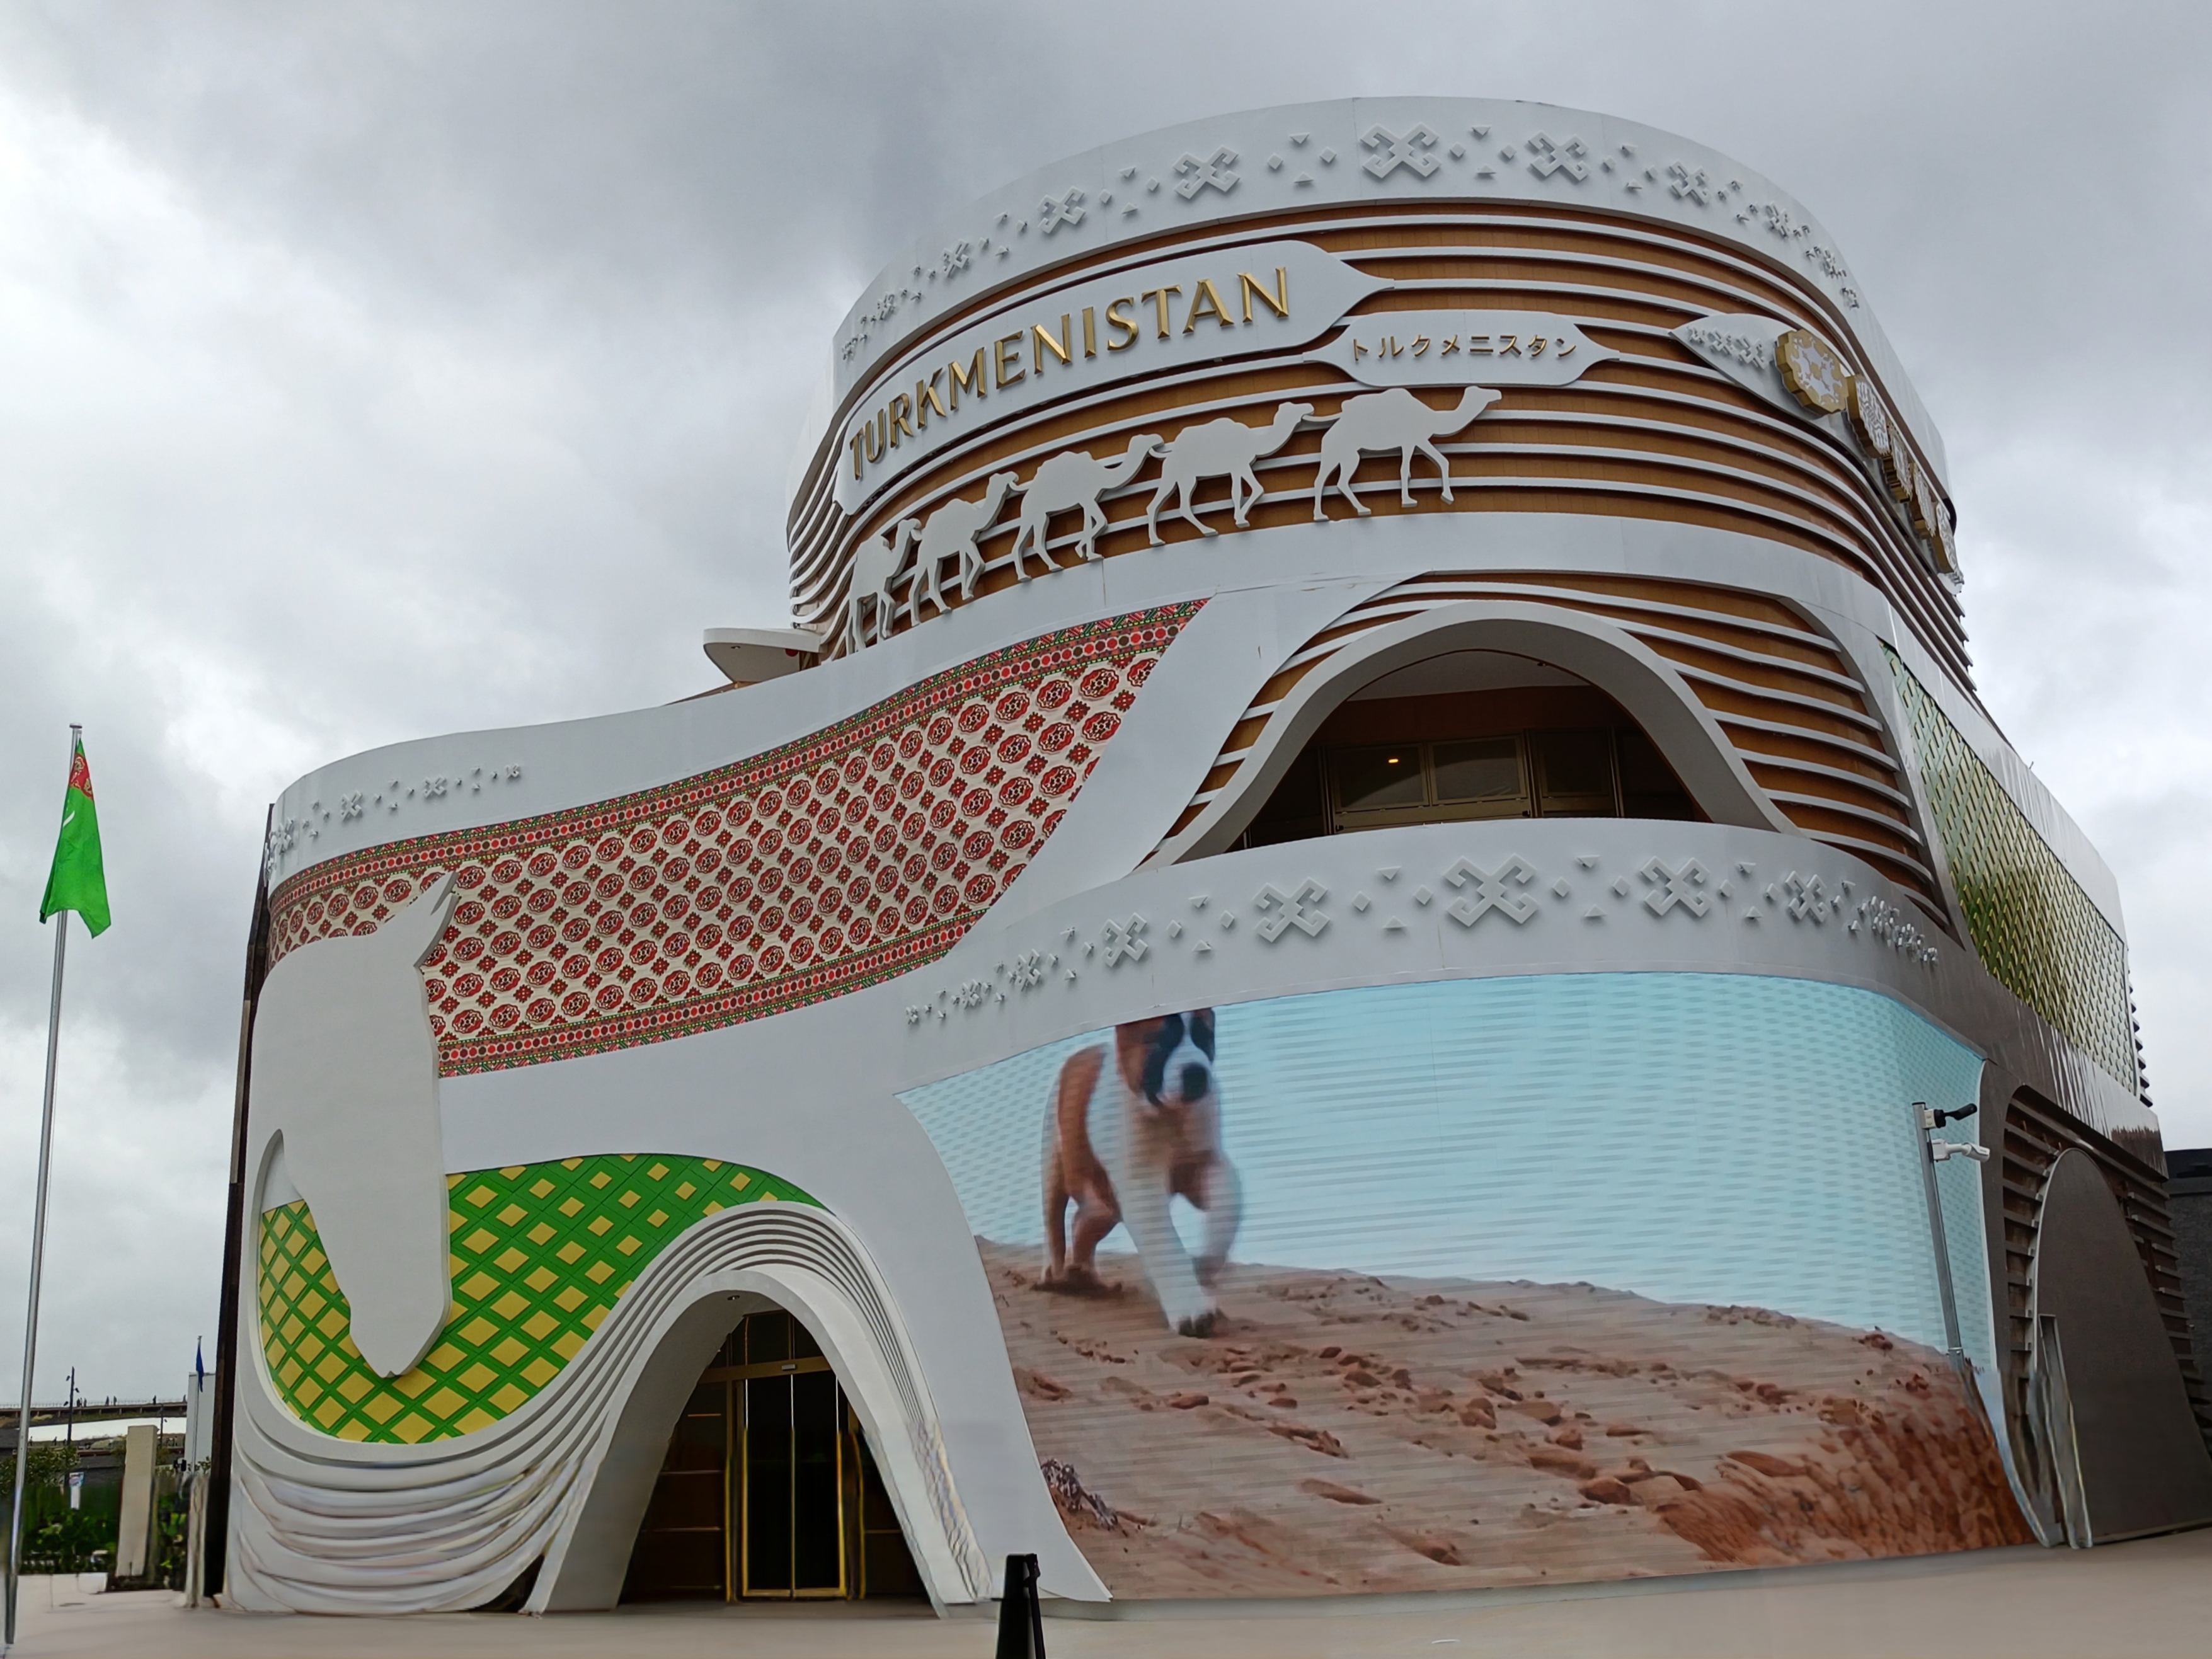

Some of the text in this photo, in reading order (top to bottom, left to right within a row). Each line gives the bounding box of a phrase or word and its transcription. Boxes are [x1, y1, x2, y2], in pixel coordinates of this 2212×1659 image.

[849, 267, 1289, 481] TURKMENISTAN
[1353, 334, 1576, 361] トルクメニスタン
